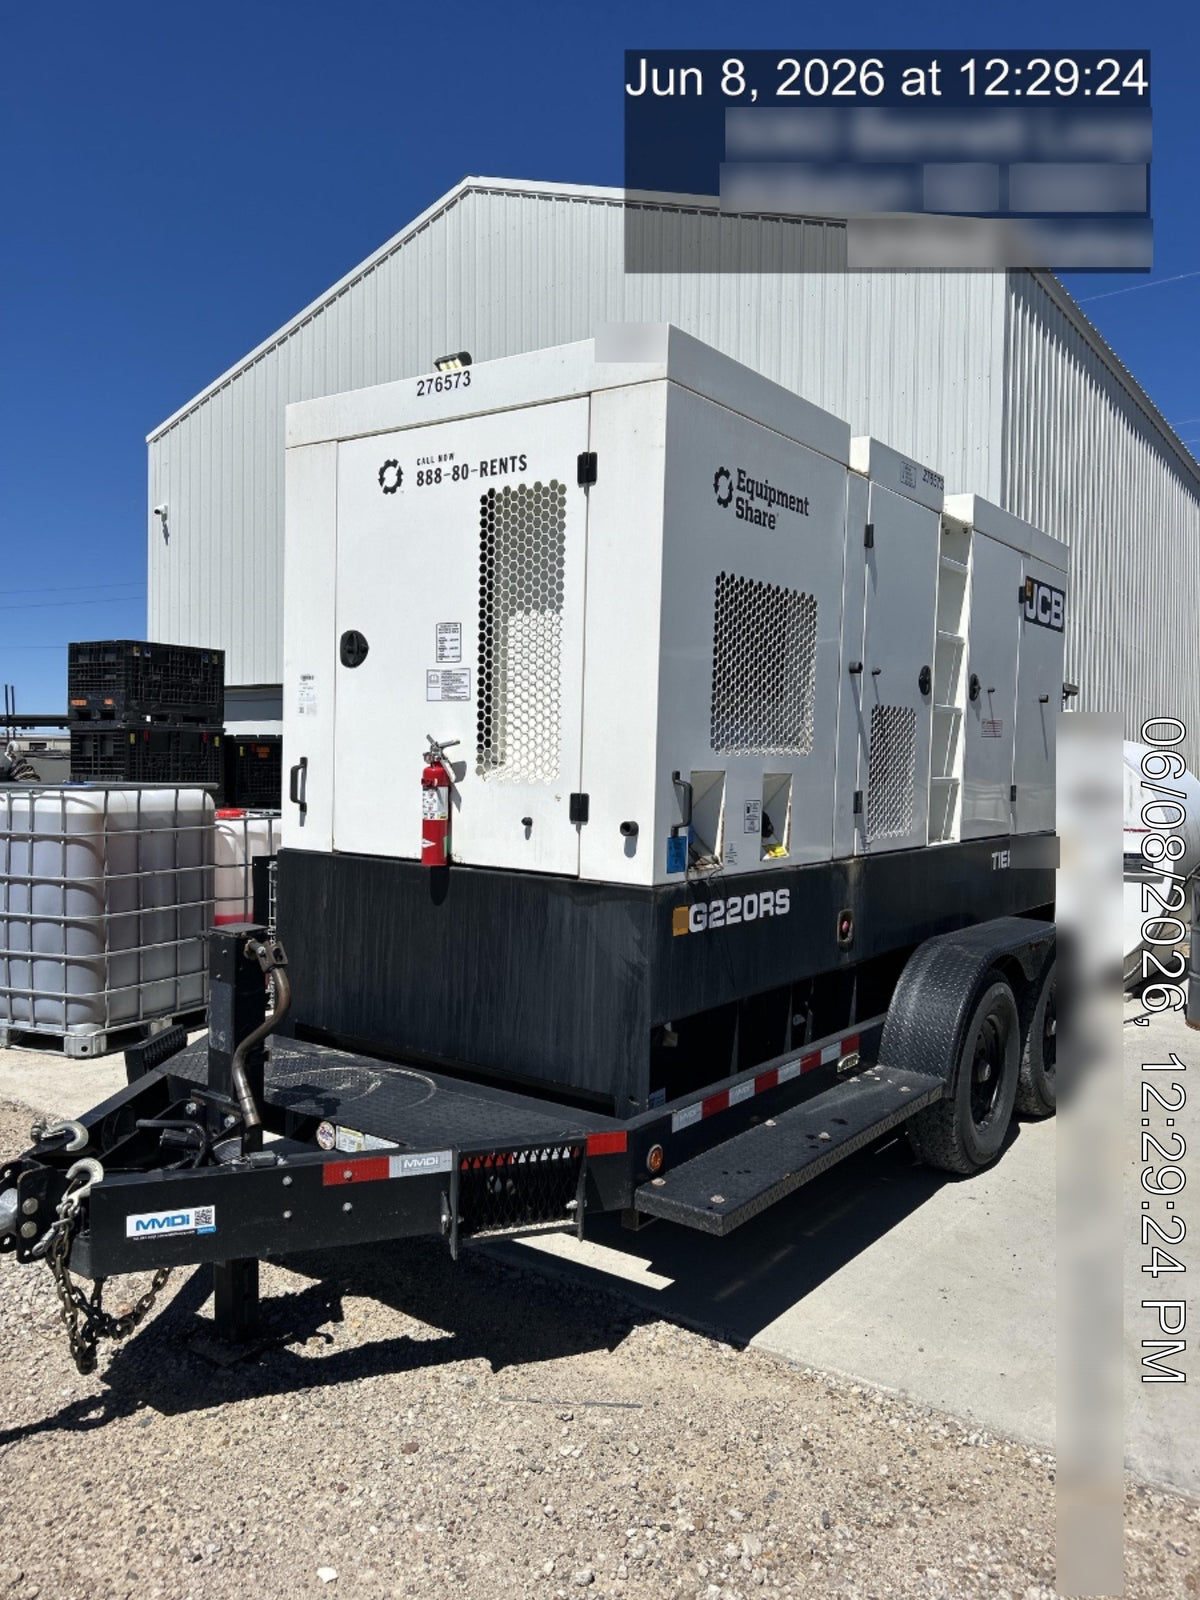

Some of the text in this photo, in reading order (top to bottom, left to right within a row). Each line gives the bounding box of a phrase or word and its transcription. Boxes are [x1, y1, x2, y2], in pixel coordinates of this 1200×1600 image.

[416, 370, 472, 397] 276573
[416, 453, 455, 466] CALL NOW
[416, 454, 528, 487] 888-80-RENTS
[736, 468, 810, 516] Equipment
[736, 496, 776, 530] Share
[1025, 583, 1063, 628] JCB
[688, 888, 790, 933] G220RS
